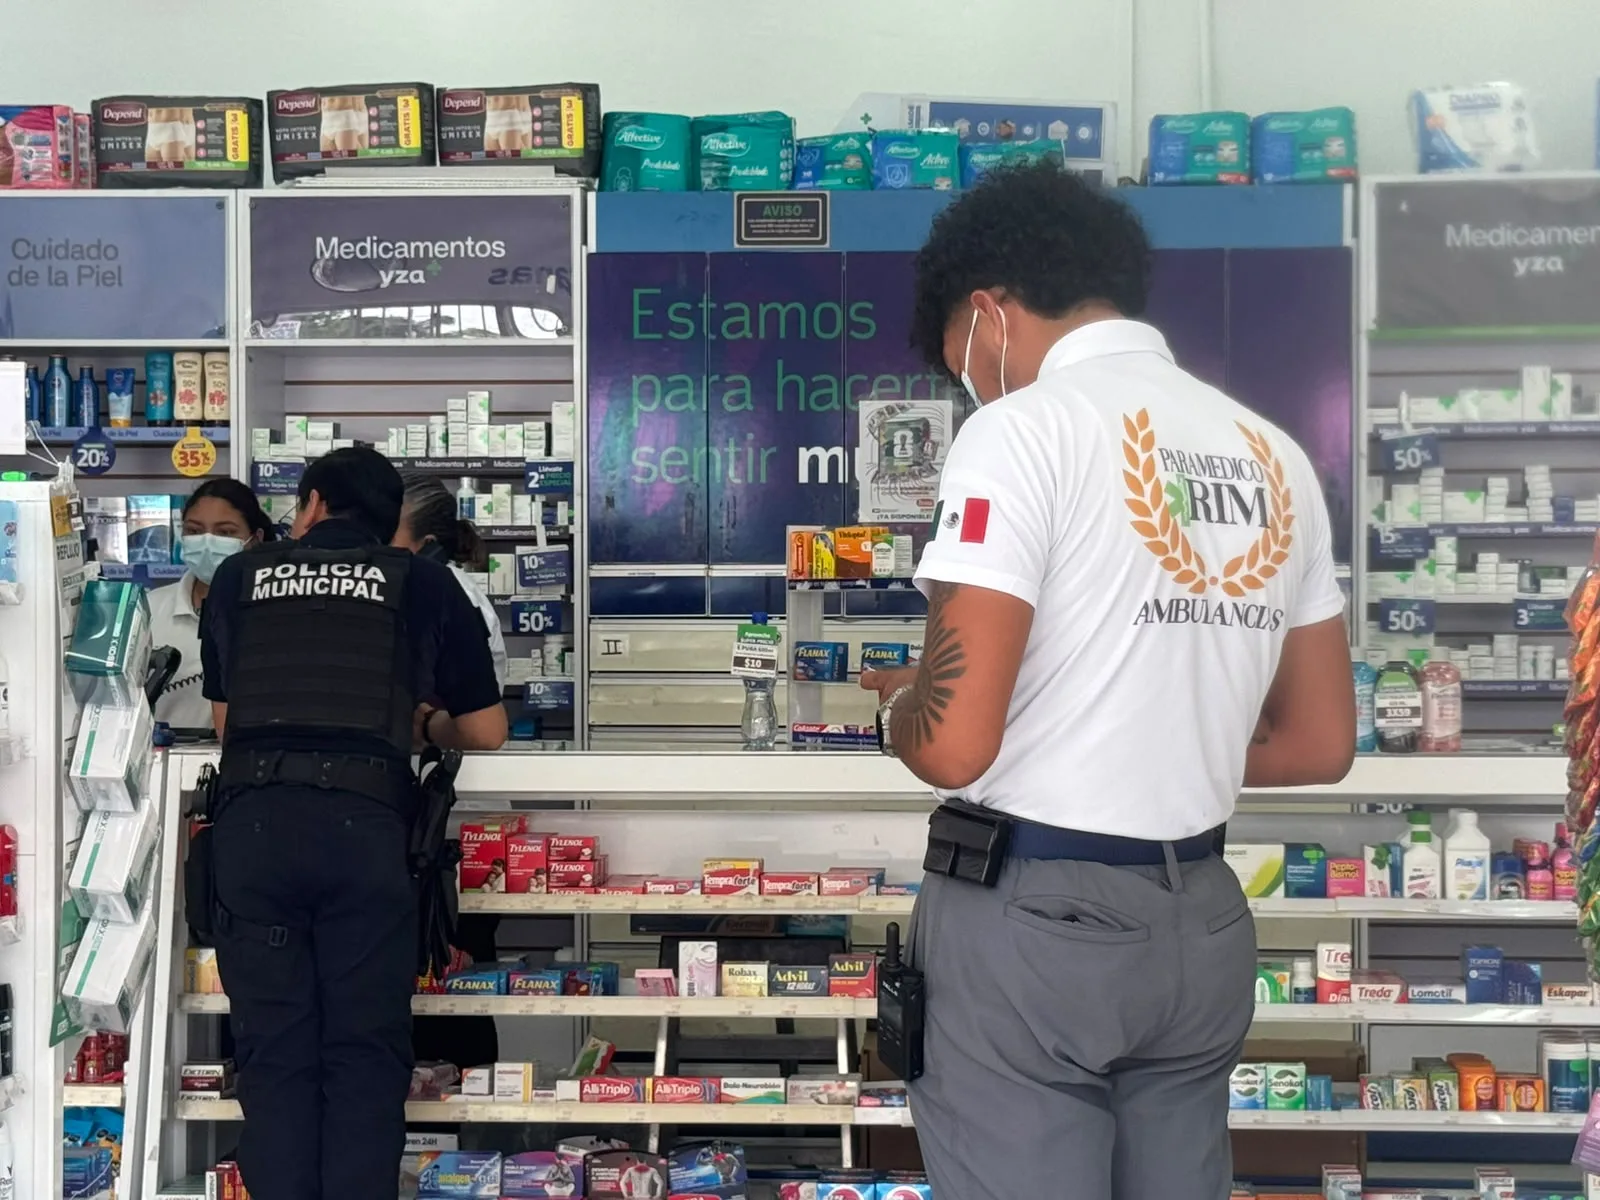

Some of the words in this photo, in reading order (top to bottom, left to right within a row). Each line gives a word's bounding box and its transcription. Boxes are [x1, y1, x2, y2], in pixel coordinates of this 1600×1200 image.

[278, 98, 316, 112] Depend
[444, 97, 481, 110] Depend
[103, 108, 142, 121] Depend
[275, 132, 317, 141] UNISEX
[441, 131, 481, 140] UNISEX
[100, 142, 143, 150] UNISEX
[762, 204, 803, 217] AVISO
[11, 237, 119, 262] Cuidado
[315, 236, 506, 260] Medicamentos
[1513, 257, 1564, 277] yza
[7, 265, 39, 288] de
[47, 265, 70, 288] la
[77, 264, 123, 288] Piel
[378, 269, 426, 289] yza
[632, 288, 877, 341] Estamos
[631, 372, 754, 428] para
[777, 359, 946, 412] hacert
[77, 448, 110, 468] 20%
[177, 450, 211, 468] 35%
[493, 460, 526, 468] Medicam
[631, 432, 777, 485] sentir
[798, 446, 860, 485] m
[1392, 447, 1433, 471] 50%
[258, 463, 280, 477] 10%
[1157, 446, 1266, 484] PARAMEDICO
[1184, 477, 1272, 529] RIM
[492, 528, 536, 537] Medicament
[522, 554, 546, 570] 10%
[251, 577, 386, 602] MUNICIPAL
[518, 610, 554, 633] 50%
[1388, 609, 1427, 631] 50%
[797, 648, 831, 658] FLANAX
[864, 649, 902, 660] FLANAX
[744, 657, 762, 668] $10
[528, 682, 552, 696] 10%
[462, 831, 502, 841] TYLENOL
[549, 837, 584, 847] TYLENOL
[509, 843, 543, 853] TYLENOL
[549, 863, 586, 872] TYLENOL
[645, 880, 675, 894] Tempra
[821, 876, 850, 890] Tempra
[1325, 948, 1351, 963] Tre
[727, 967, 758, 977] Robax
[830, 960, 865, 972] Advil
[772, 970, 809, 982] Advil
[451, 978, 497, 990] FLANAX
[514, 978, 559, 990] FLANAX
[1357, 986, 1394, 998] Treda
[1546, 987, 1589, 999] Eskapar
[1267, 1078, 1304, 1088] Senokot
[422, 1137, 438, 1145] 24H
